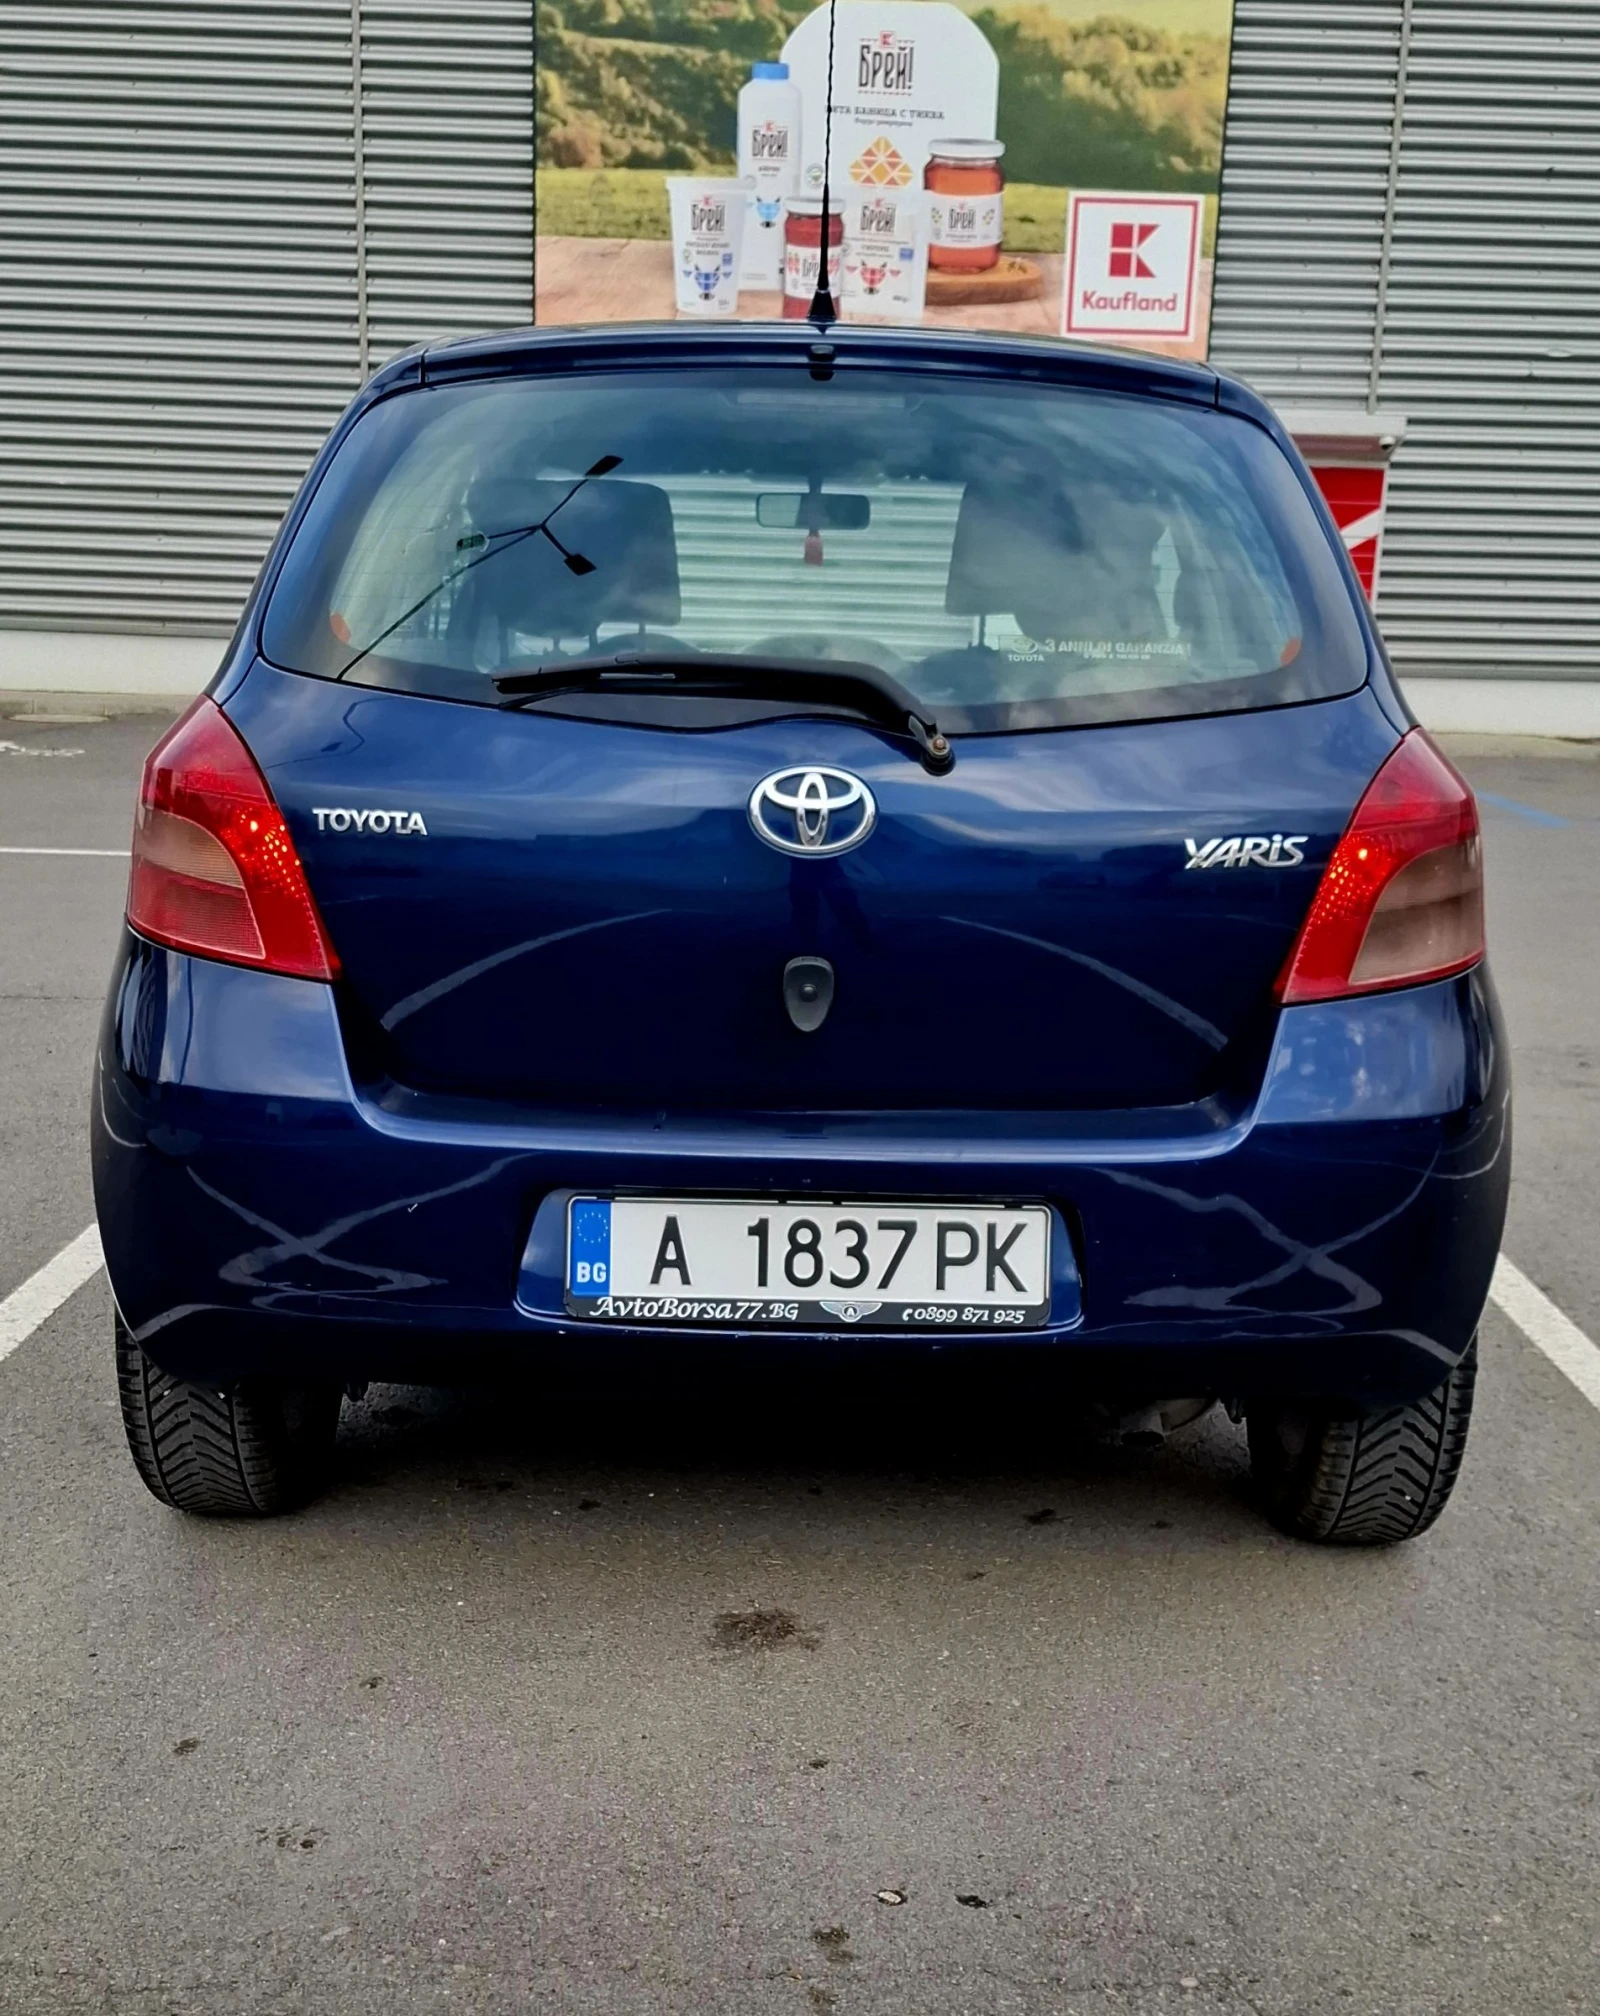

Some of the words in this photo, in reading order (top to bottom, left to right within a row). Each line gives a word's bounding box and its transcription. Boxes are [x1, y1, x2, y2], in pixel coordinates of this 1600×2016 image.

[858, 44, 914, 90] Брей!
[1082, 290, 1178, 312] Kaufland
[1045, 639, 1057, 652] 3
[1058, 640, 1093, 653] ANNI
[1007, 653, 1045, 663] TOYOTA
[312, 808, 428, 836] TOYOTA
[650, 1215, 692, 1286] A
[747, 1217, 918, 1290] 1837
[935, 1220, 1029, 1293] PK
[576, 1261, 607, 1283] BG
[589, 1296, 799, 1321] AvtoBorsa77.BG
[914, 1306, 958, 1323] 0899
[962, 1307, 989, 1323] 871
[993, 1309, 1026, 1324] 925
